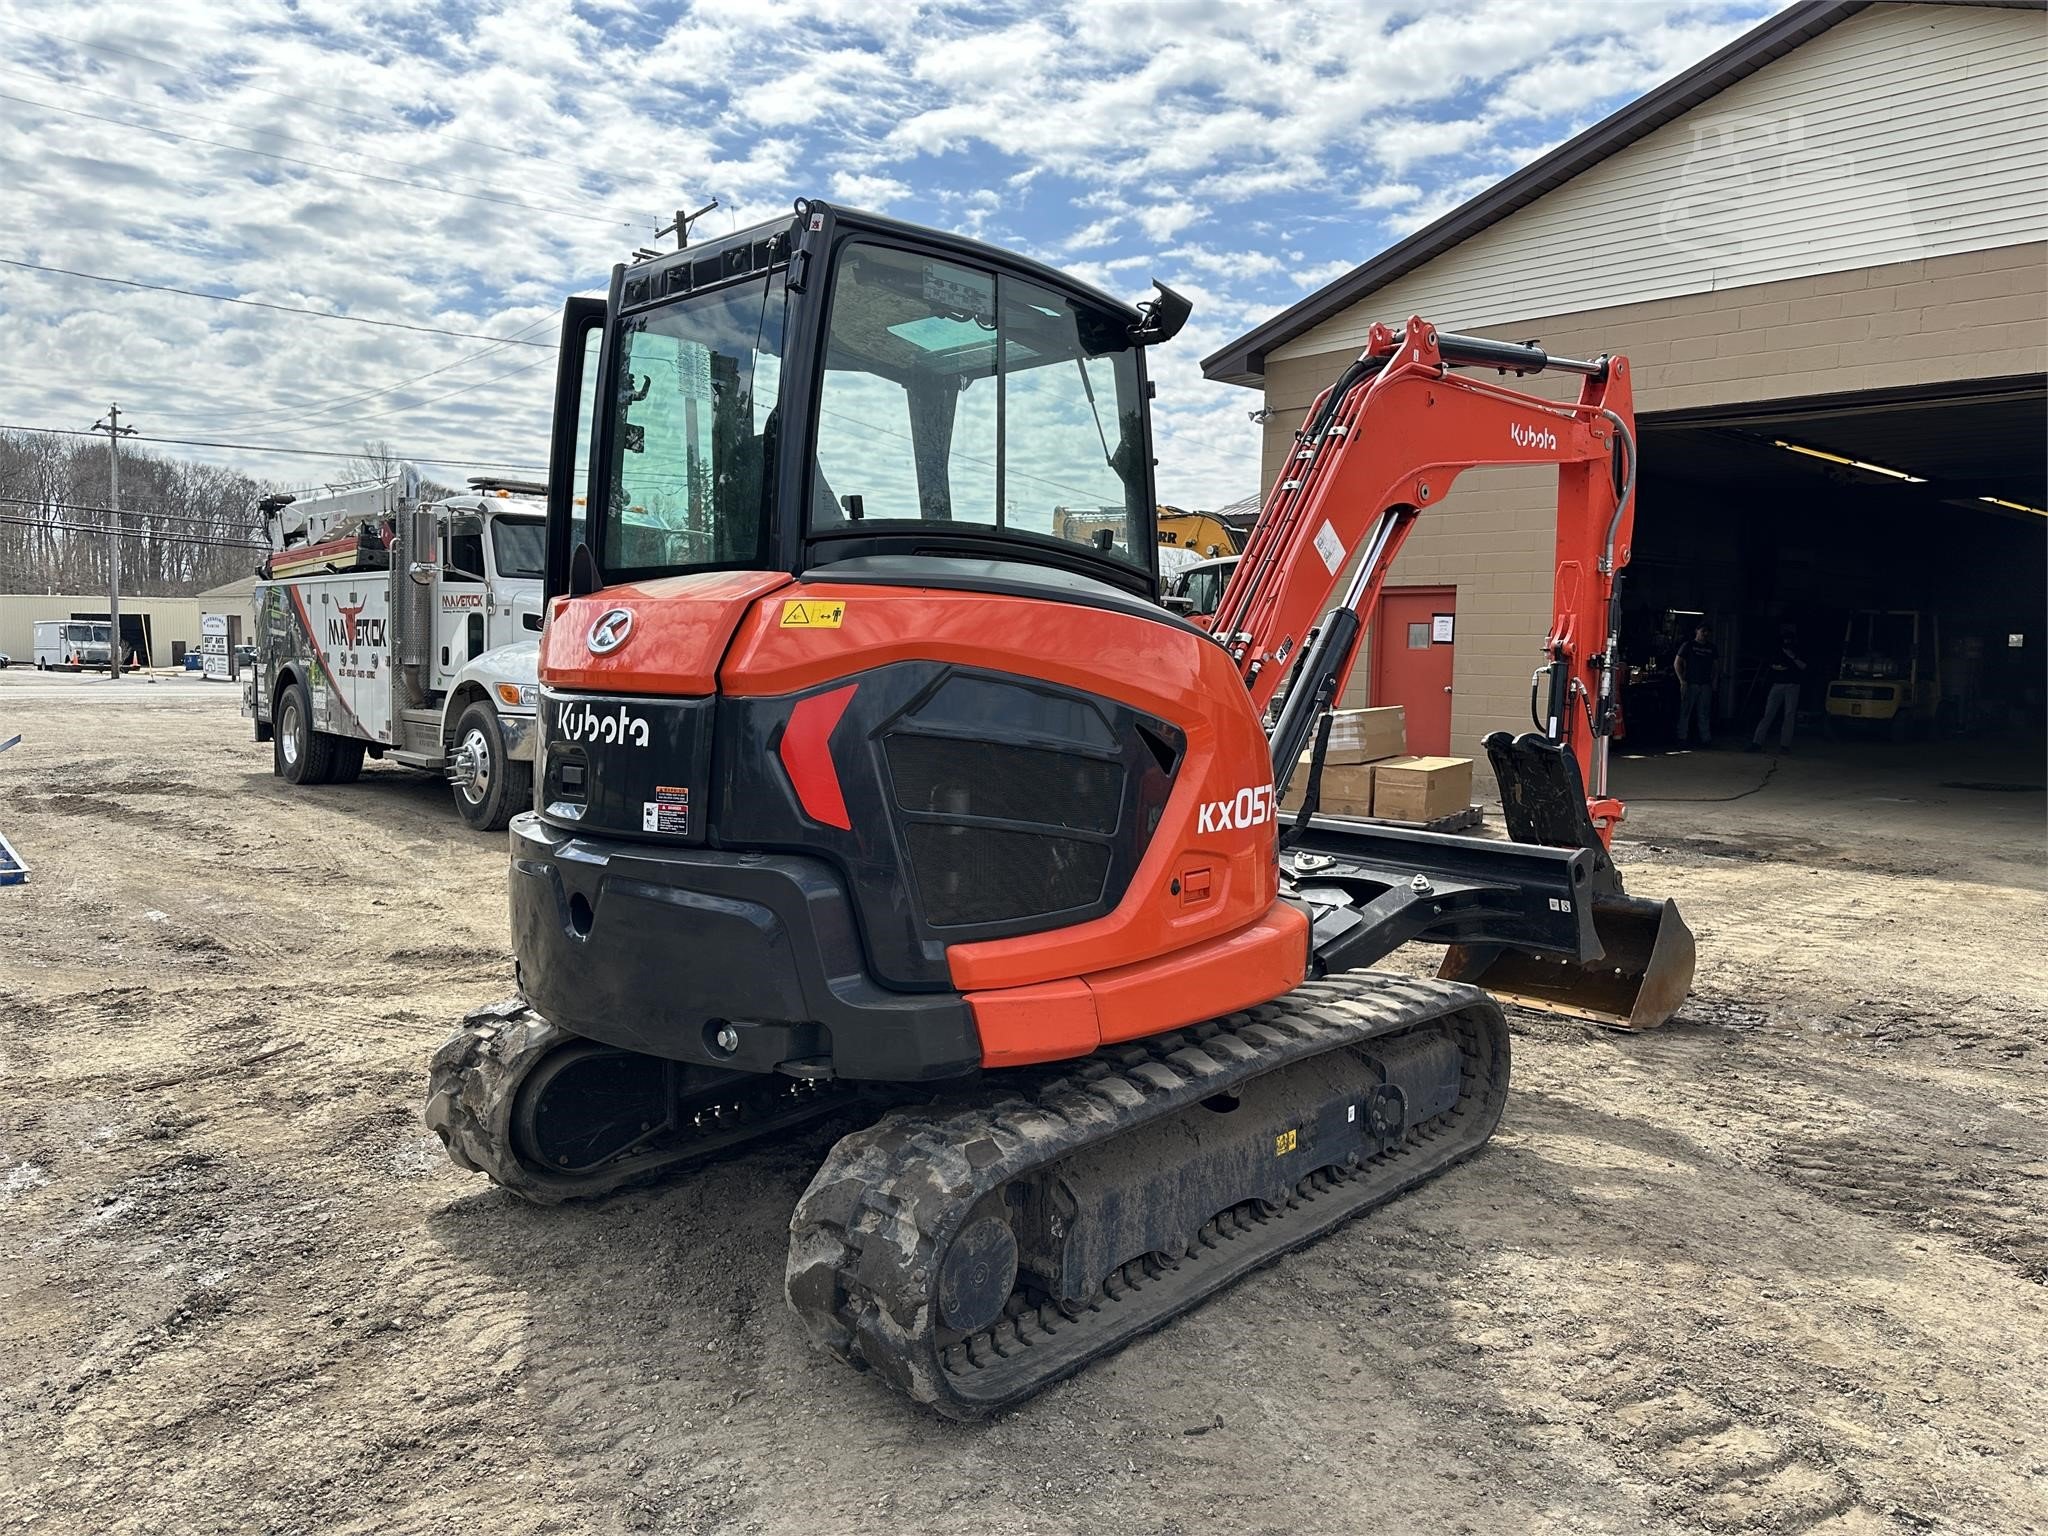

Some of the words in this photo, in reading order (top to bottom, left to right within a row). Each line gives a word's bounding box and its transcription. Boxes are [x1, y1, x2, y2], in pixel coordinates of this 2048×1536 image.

[1511, 422, 1556, 450] Kubota
[442, 594, 483, 607] MAVERICK
[329, 617, 386, 650] MAVERICK
[558, 702, 649, 747] Kubota
